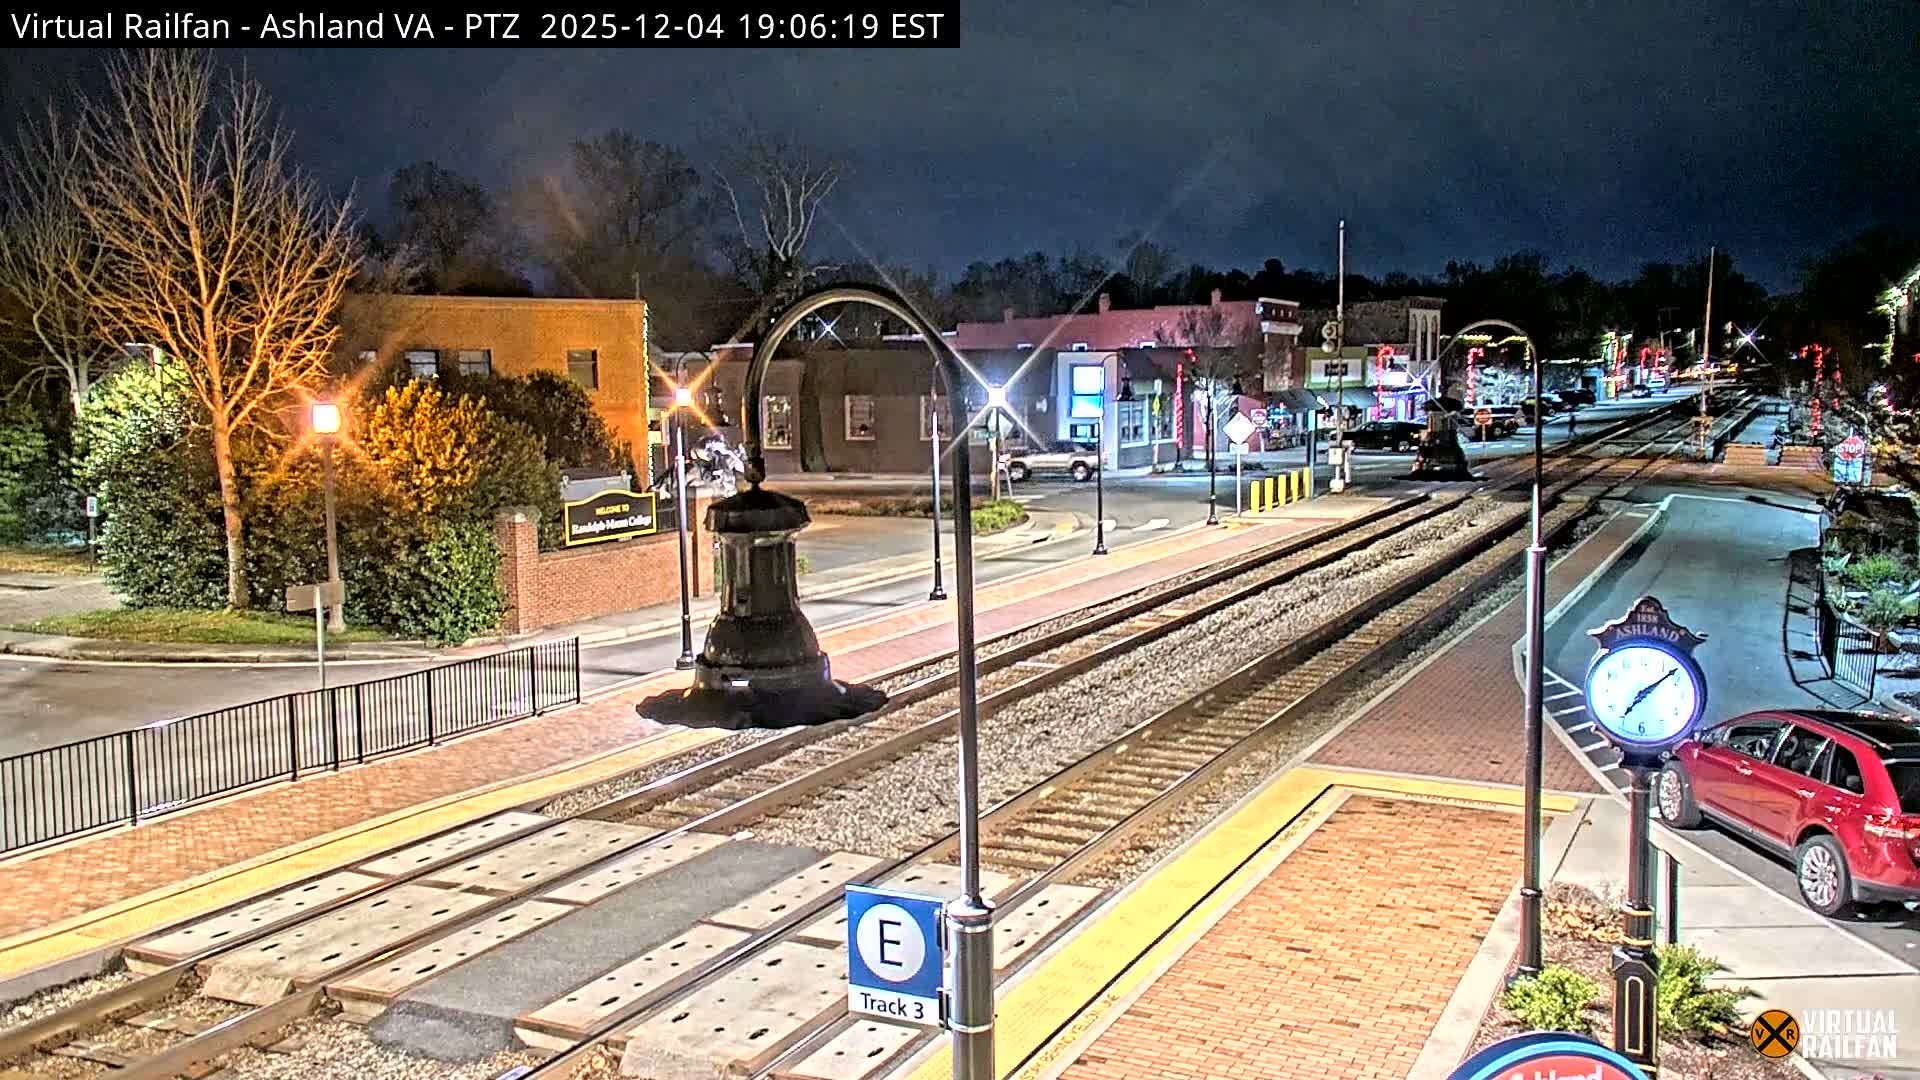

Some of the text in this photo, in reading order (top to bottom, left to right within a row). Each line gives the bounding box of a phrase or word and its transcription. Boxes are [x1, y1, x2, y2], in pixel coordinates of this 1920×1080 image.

[1838, 443, 1862, 453] STOP
[1616, 624, 1680, 642] ASHLAND
[879, 919, 903, 967] E
[860, 992, 924, 1020] Track 3
